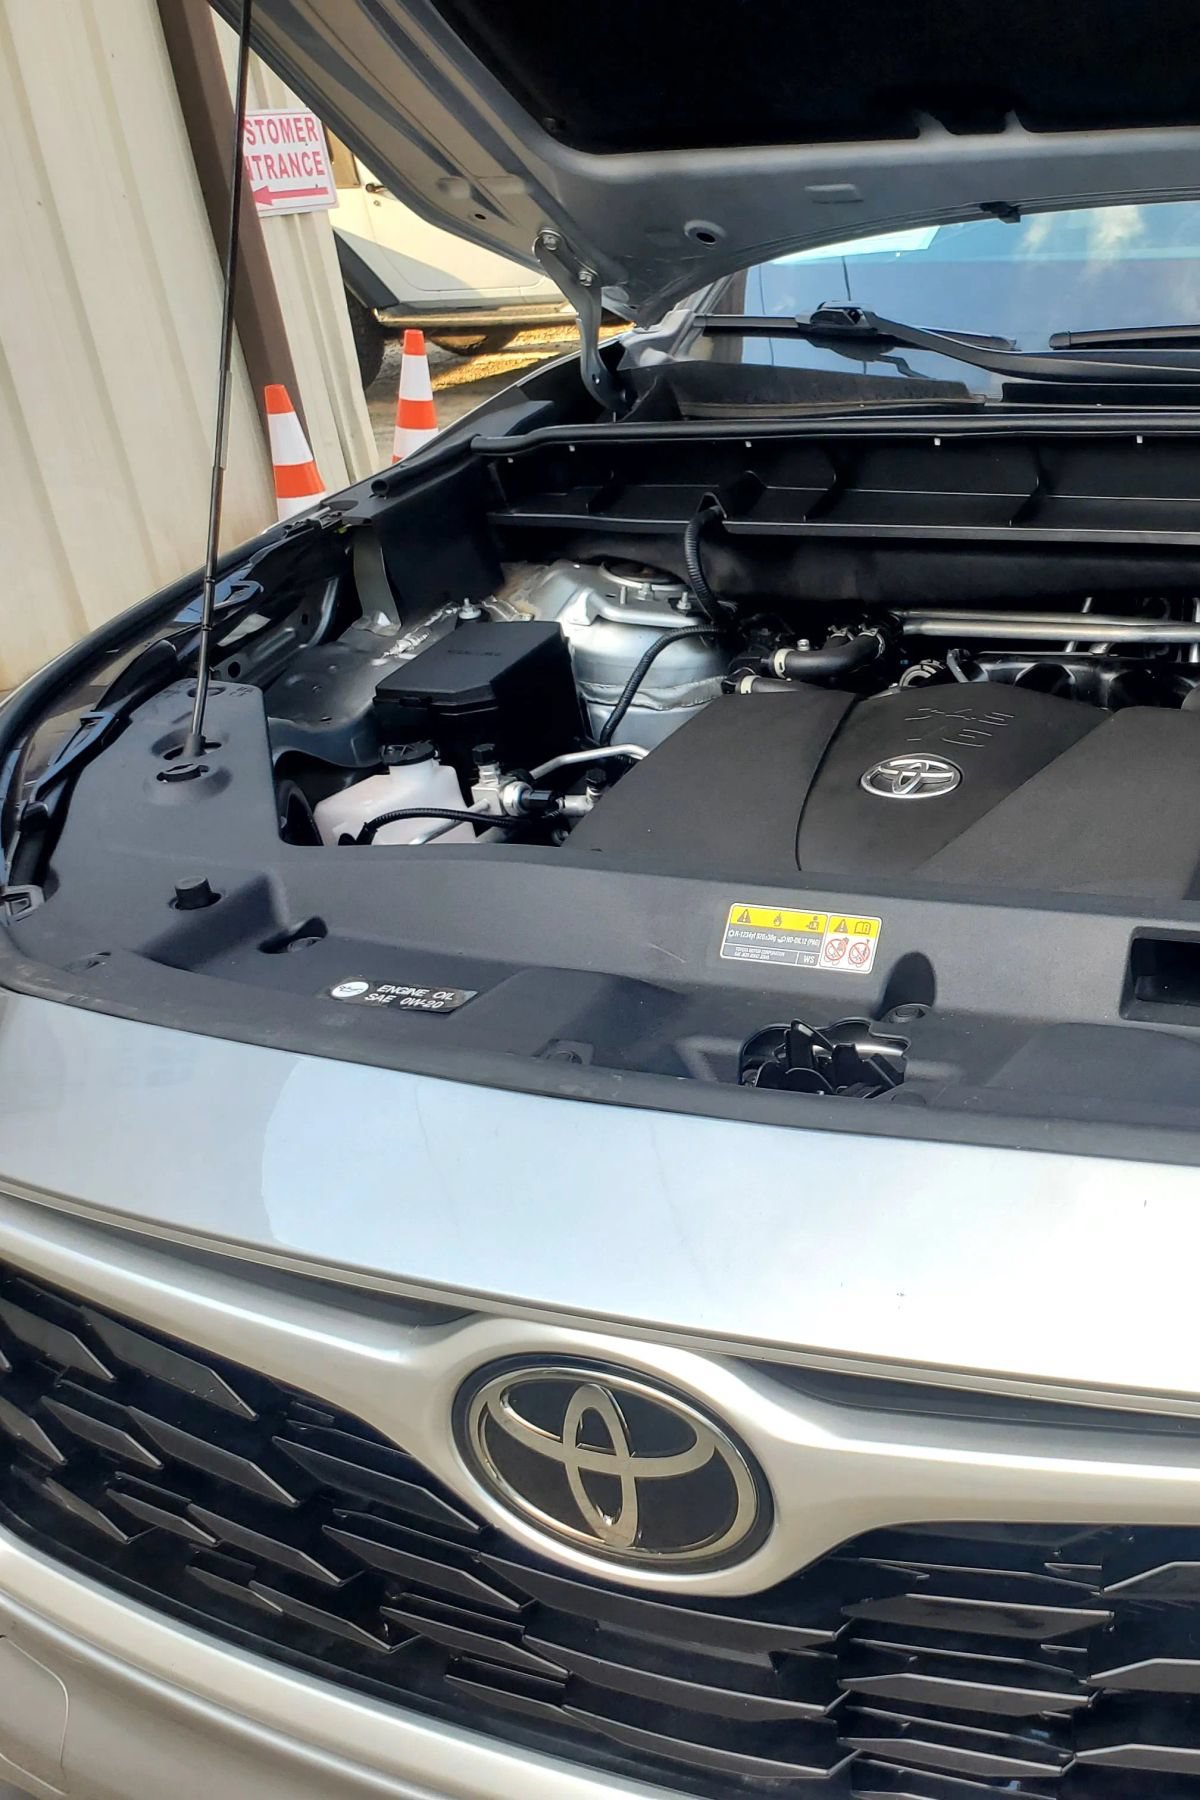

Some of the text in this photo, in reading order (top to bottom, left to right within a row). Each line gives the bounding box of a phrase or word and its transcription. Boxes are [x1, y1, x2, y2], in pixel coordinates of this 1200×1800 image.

[803, 955, 815, 964] WS
[377, 984, 455, 1001] ENGINE OIL
[364, 993, 445, 1008] SAE 0W-20
